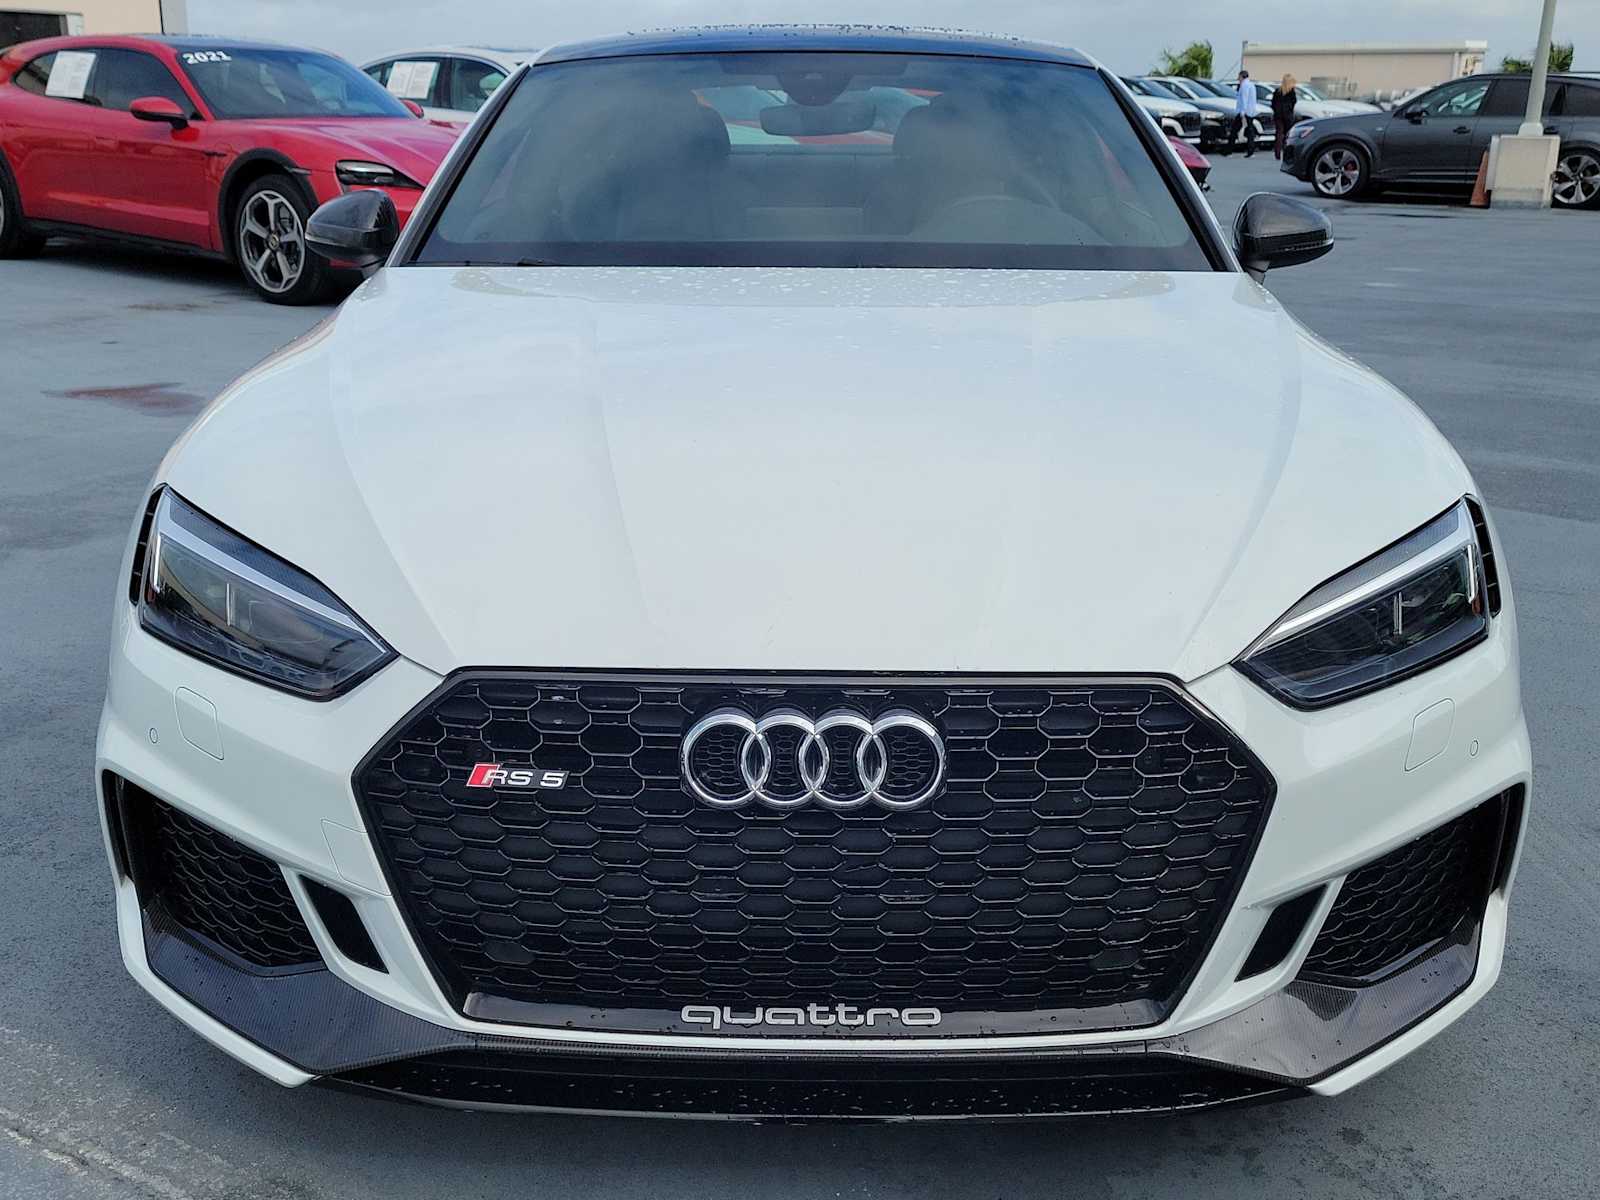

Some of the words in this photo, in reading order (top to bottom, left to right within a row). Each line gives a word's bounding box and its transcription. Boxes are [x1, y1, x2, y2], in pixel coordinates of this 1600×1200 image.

[182, 51, 232, 64] 2021
[480, 768, 533, 786] RS
[540, 772, 566, 787] 5
[681, 1002, 942, 1030] quattro
